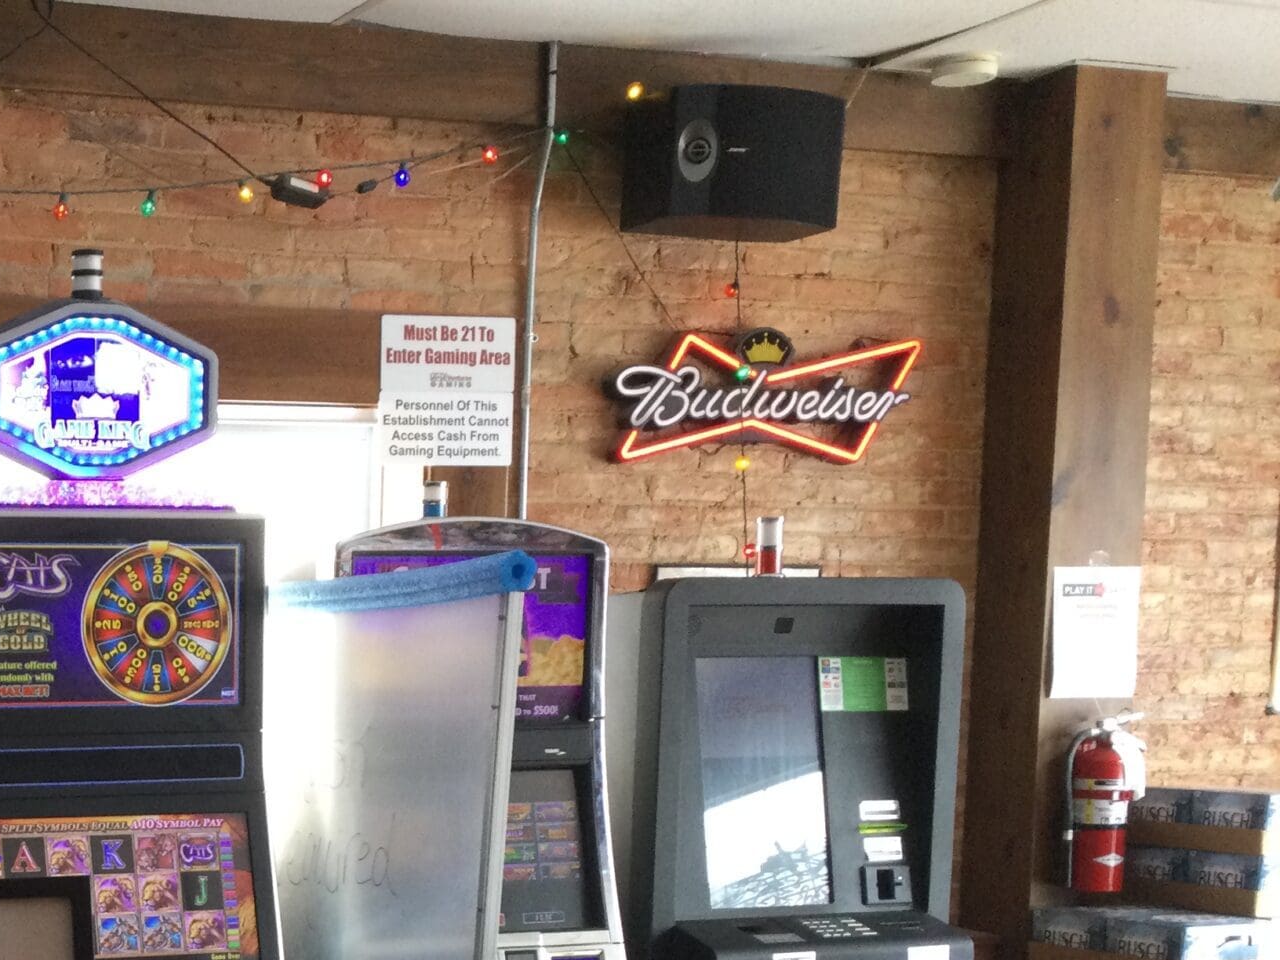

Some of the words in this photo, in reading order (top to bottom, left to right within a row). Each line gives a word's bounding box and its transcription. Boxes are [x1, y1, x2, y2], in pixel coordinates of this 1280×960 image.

[403, 325, 438, 341] Must
[440, 325, 458, 342] Be
[461, 326, 477, 342] 21
[478, 326, 495, 343] To
[386, 347, 422, 364] Enter
[424, 348, 477, 367] Gaming
[479, 350, 511, 366] Area
[616, 366, 911, 427] Budweiser
[395, 399, 454, 411] Personnel
[456, 400, 470, 411] Of
[474, 400, 498, 412] This
[382, 414, 466, 426] Establishment
[468, 415, 509, 427] Cannot
[391, 430, 434, 441] Access
[437, 430, 466, 441] Cash
[470, 430, 500, 442] From
[388, 445, 434, 459] Gaming
[437, 445, 501, 459] Equipment.
[1064, 585, 1086, 595] PLAY
[1086, 586, 1094, 595] IT
[24, 660, 58, 670] offered
[34, 672, 55, 682] with
[0, 823, 34, 834] SPLIT
[36, 822, 89, 833] SYMBOLS
[90, 821, 130, 833] EQUAL
[141, 819, 155, 830] 10
[155, 819, 202, 830] SYMBOL
[202, 817, 224, 828] PAY
[1202, 809, 1252, 829] BUSCH
[100, 839, 126, 870] K
[1199, 869, 1247, 889] BUSCH
[1042, 928, 1091, 950] BUSCH
[1117, 938, 1167, 960] BUSCH
